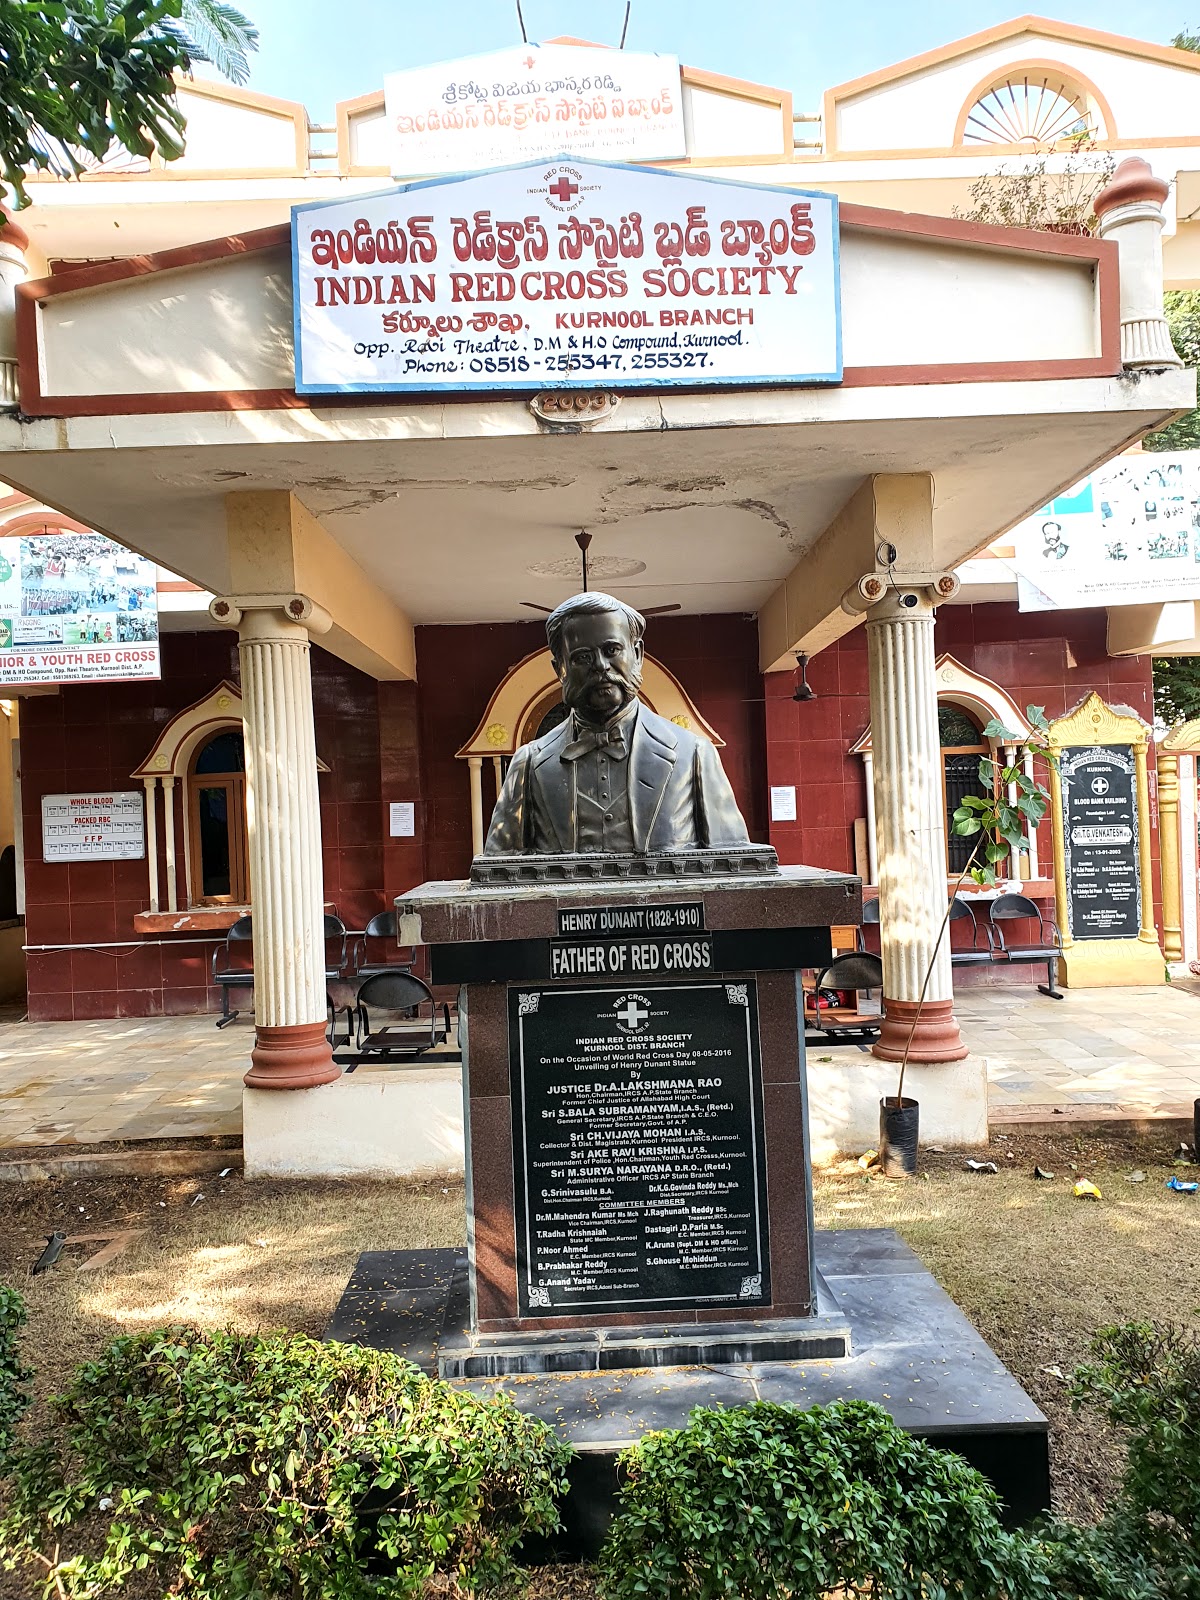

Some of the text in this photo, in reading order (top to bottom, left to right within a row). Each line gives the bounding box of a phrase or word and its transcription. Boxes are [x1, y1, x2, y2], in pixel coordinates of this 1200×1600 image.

[492, 80, 541, 97] విజయ
[397, 105, 479, 133] ఇండియన్
[544, 166, 582, 181] RED CROSS
[544, 197, 565, 212] KURNOOL
[310, 216, 438, 270] ఇండియన్
[654, 206, 711, 268] బ్లడ్
[720, 203, 816, 266] బ్యాంక్
[314, 273, 436, 306] INDIAN
[642, 266, 803, 298] SOCIETY
[556, 308, 754, 329] KURNOOL BRANCH
[354, 342, 394, 358] Opp.
[567, 335, 578, 349] &
[582, 336, 607, 349] H.O
[29, 656, 37, 667] &
[41, 654, 83, 666] YOUTH
[87, 653, 111, 664] RED
[115, 651, 156, 662] CROSS
[562, 907, 700, 931] HENRY DUNANT (1828-1910)
[552, 942, 711, 974] FATHER OF RED CROSS
[613, 994, 651, 1008] RED CROSS
[584, 1044, 625, 1052] KURNOOL
[566, 1055, 600, 1063] Occasion
[692, 1049, 732, 1057] 08-05-2016
[574, 1063, 609, 1071] Unveiling
[630, 1071, 641, 1079] By
[547, 1078, 722, 1094] JUSTICE Dr.A.LAKSHMANA RAO
[542, 1110, 555, 1118] Sri
[558, 1108, 596, 1118] S.BALA
[707, 1103, 734, 1111] (Retd.)
[570, 1132, 584, 1141] Sri
[587, 1130, 640, 1140] CH.VIJAYA
[643, 1128, 682, 1138] MOHAN
[570, 1150, 584, 1159] Sri
[587, 1149, 608, 1158] AKE
[612, 1148, 635, 1156] RAVI
[638, 1146, 685, 1155] KRISHNA
[551, 1169, 564, 1177] Sri
[568, 1167, 613, 1177] M.SURYA
[616, 1164, 672, 1174] NARAYANA
[704, 1163, 731, 1171] (Retd.)
[541, 1188, 598, 1197] G.Srinivasulu
[647, 1198, 685, 1206] MEMBERS
[592, 1211, 616, 1219] Kumar
[644, 1207, 689, 1217] J.Raghunath
[691, 1206, 714, 1214] Reddy
[536, 1228, 607, 1238] T.Radha Krishnaiah
[645, 1224, 678, 1234] Dastagiri
[537, 1245, 588, 1254] P.Noor Ahmed
[538, 1260, 608, 1270] B.Prabhakar Reddy
[646, 1255, 717, 1265] S.Ghouse Mohiddun
[539, 1278, 571, 1286] G.Anand
